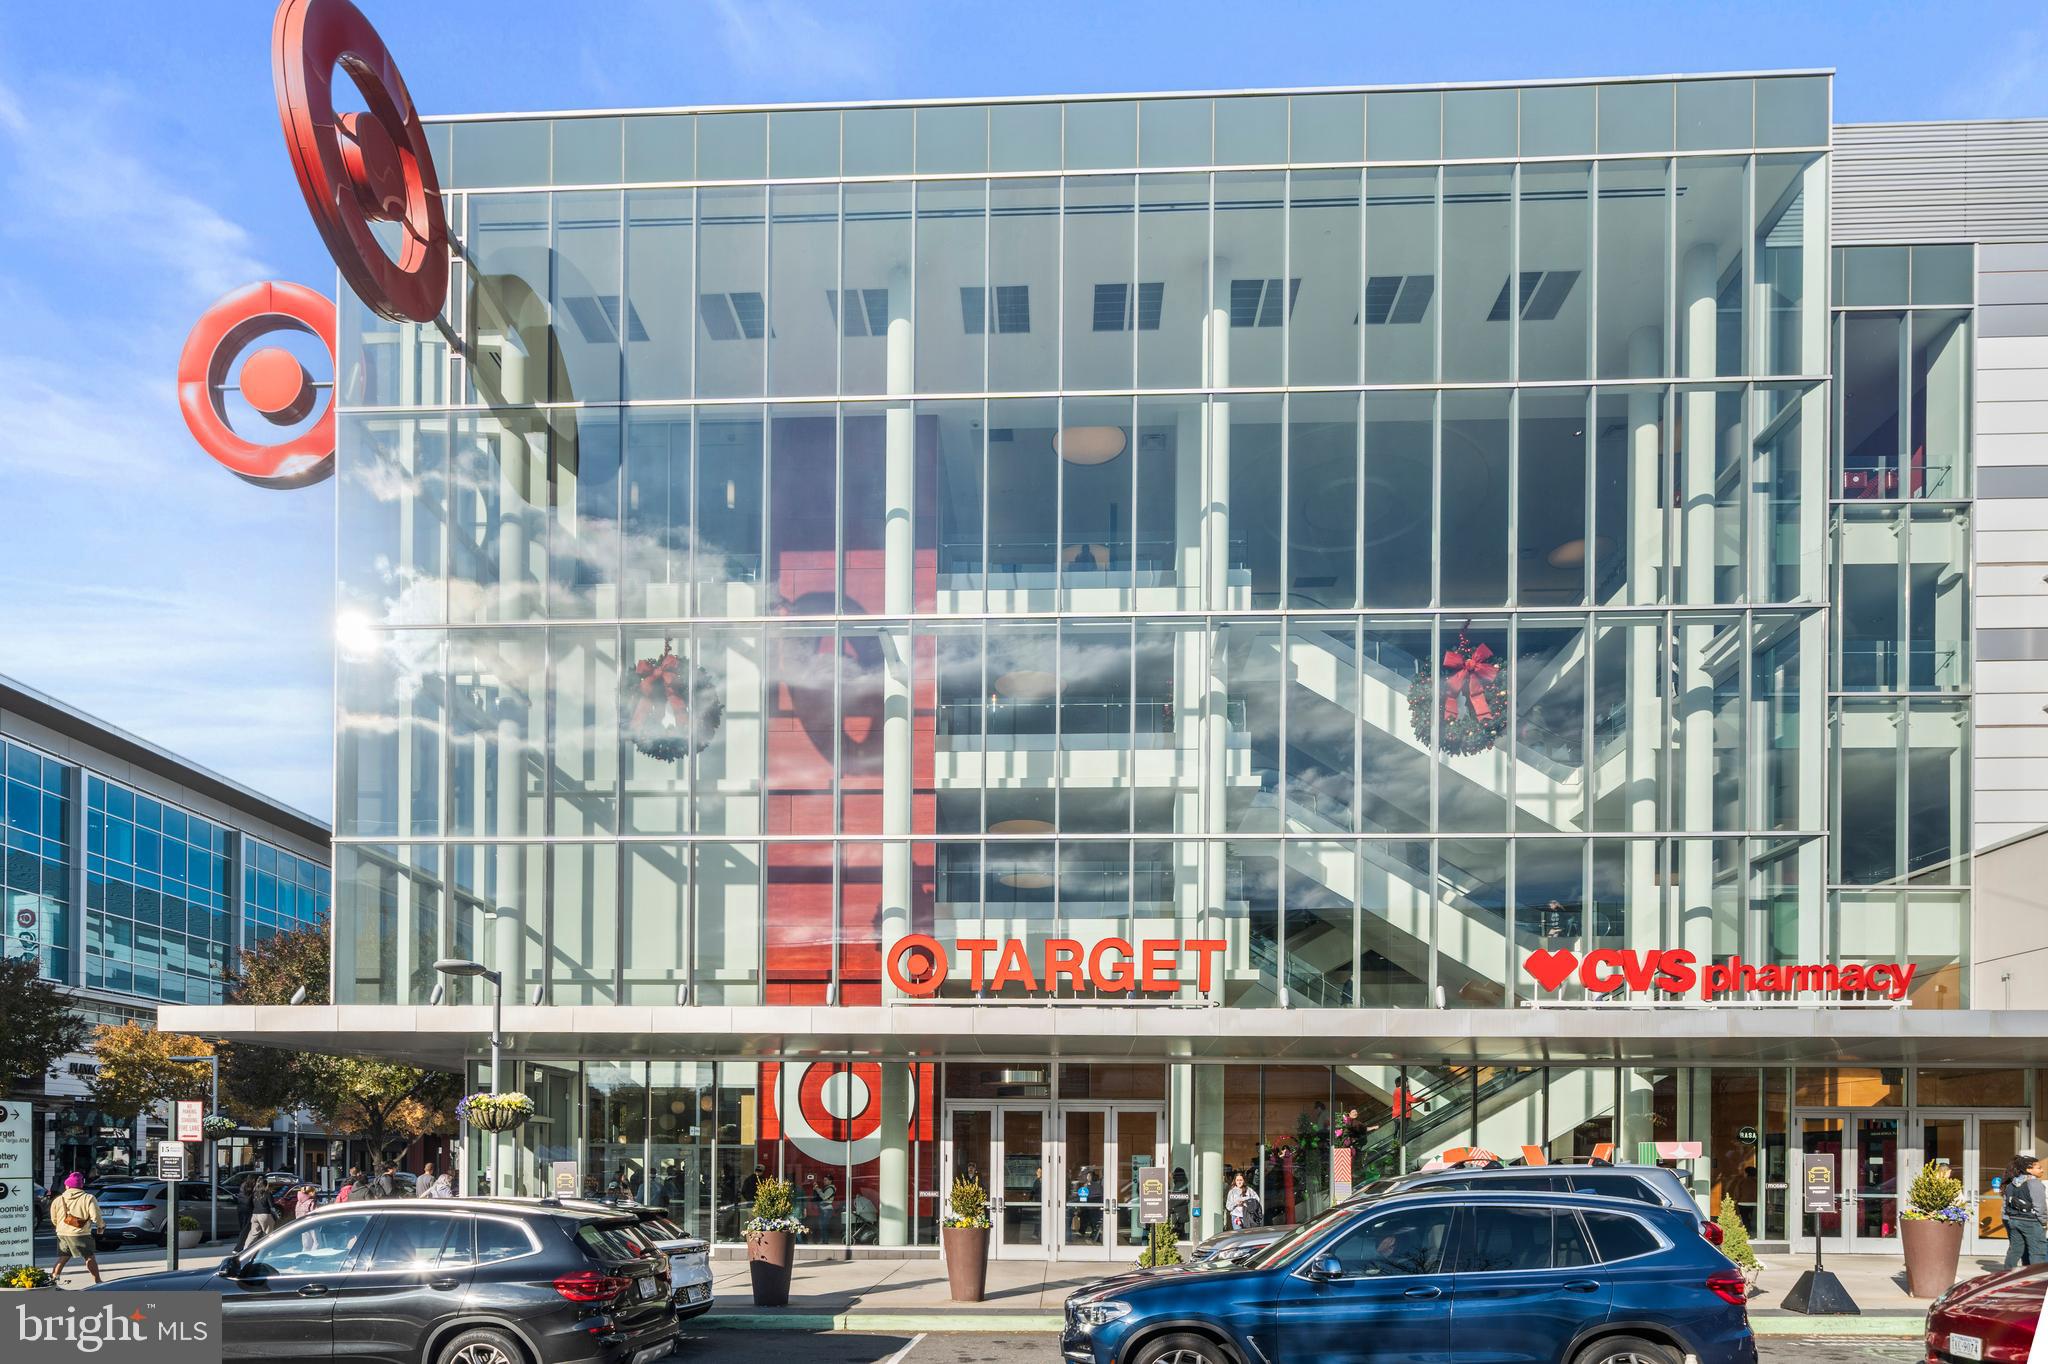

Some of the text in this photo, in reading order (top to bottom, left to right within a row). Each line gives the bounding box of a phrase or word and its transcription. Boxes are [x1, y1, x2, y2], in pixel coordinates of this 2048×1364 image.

[956, 937, 1227, 993] TARGET
[1578, 948, 1918, 1001] CVS pharmacy
